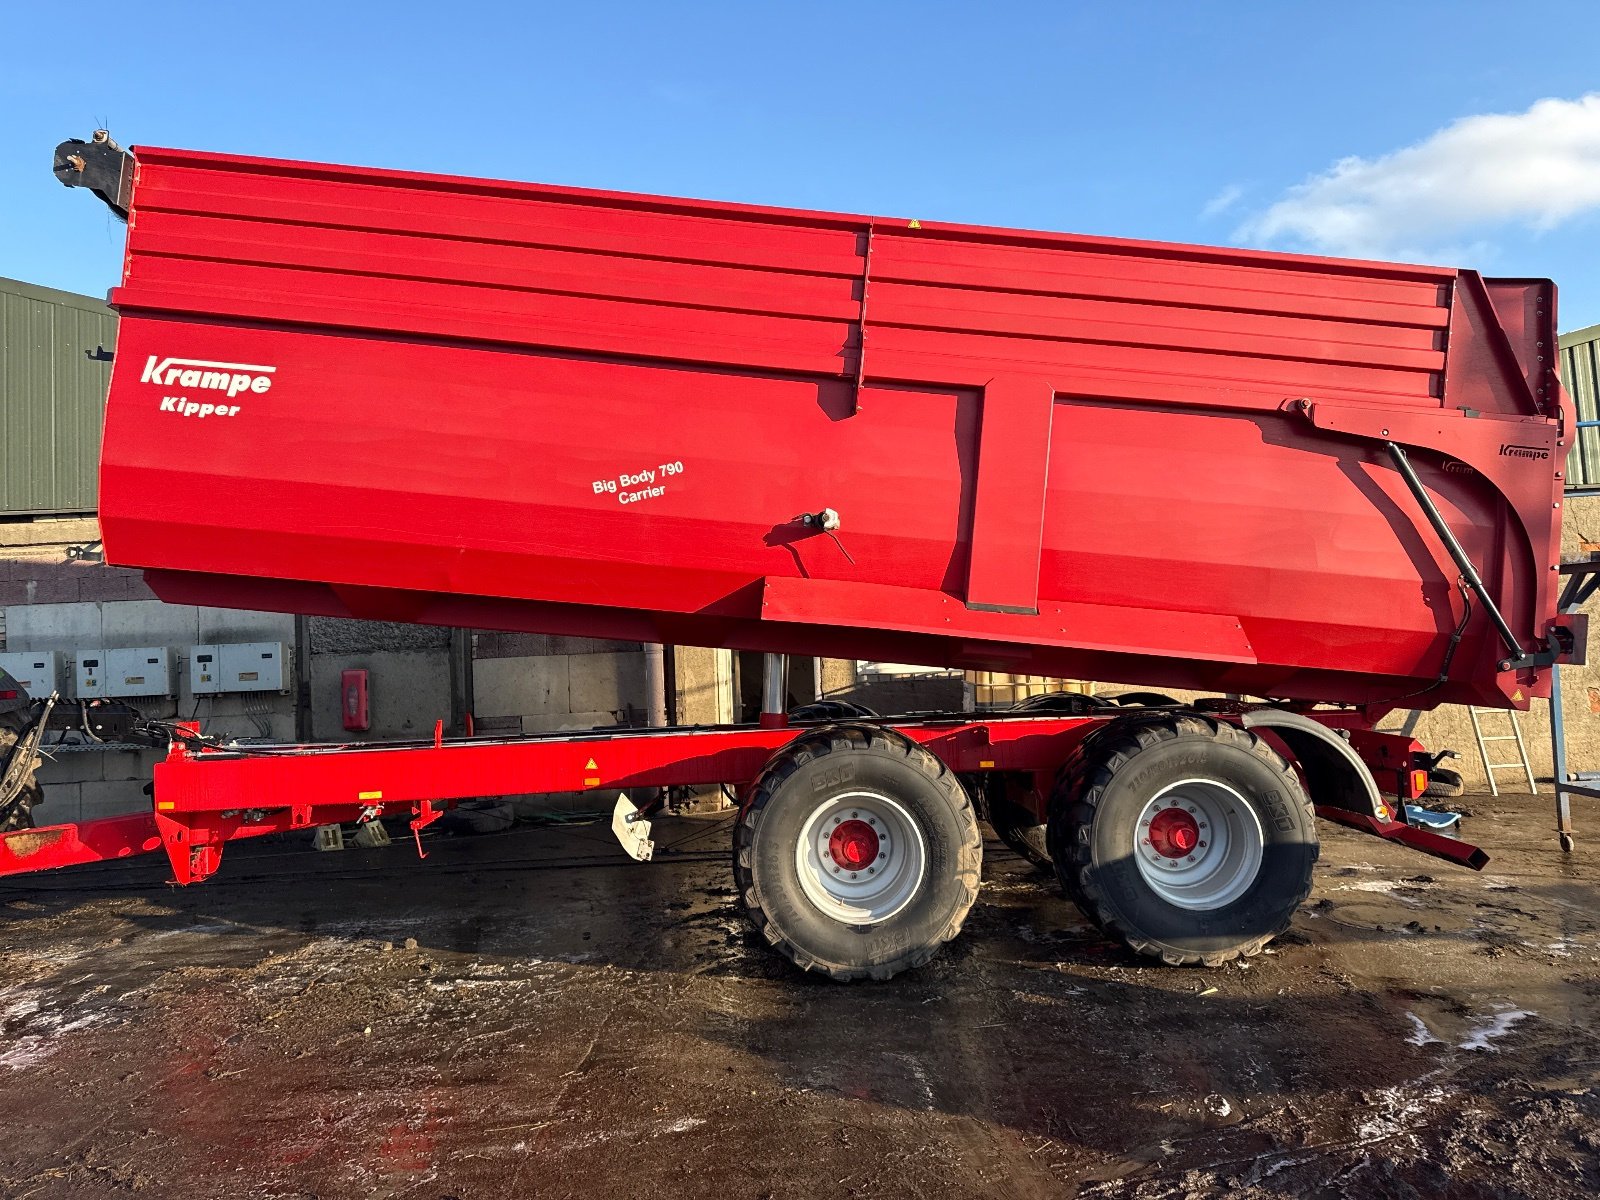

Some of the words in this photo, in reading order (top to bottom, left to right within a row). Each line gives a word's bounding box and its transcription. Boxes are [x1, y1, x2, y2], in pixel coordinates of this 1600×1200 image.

[140, 355, 277, 397] Krampe
[159, 396, 241, 418] Kipper
[1498, 444, 1550, 460] Krampe
[592, 479, 617, 495] Big
[619, 469, 656, 487] Body
[658, 461, 684, 477] 790
[618, 485, 665, 504] Carrier
[811, 761, 857, 792] BKT
[1261, 789, 1296, 833] BKT
